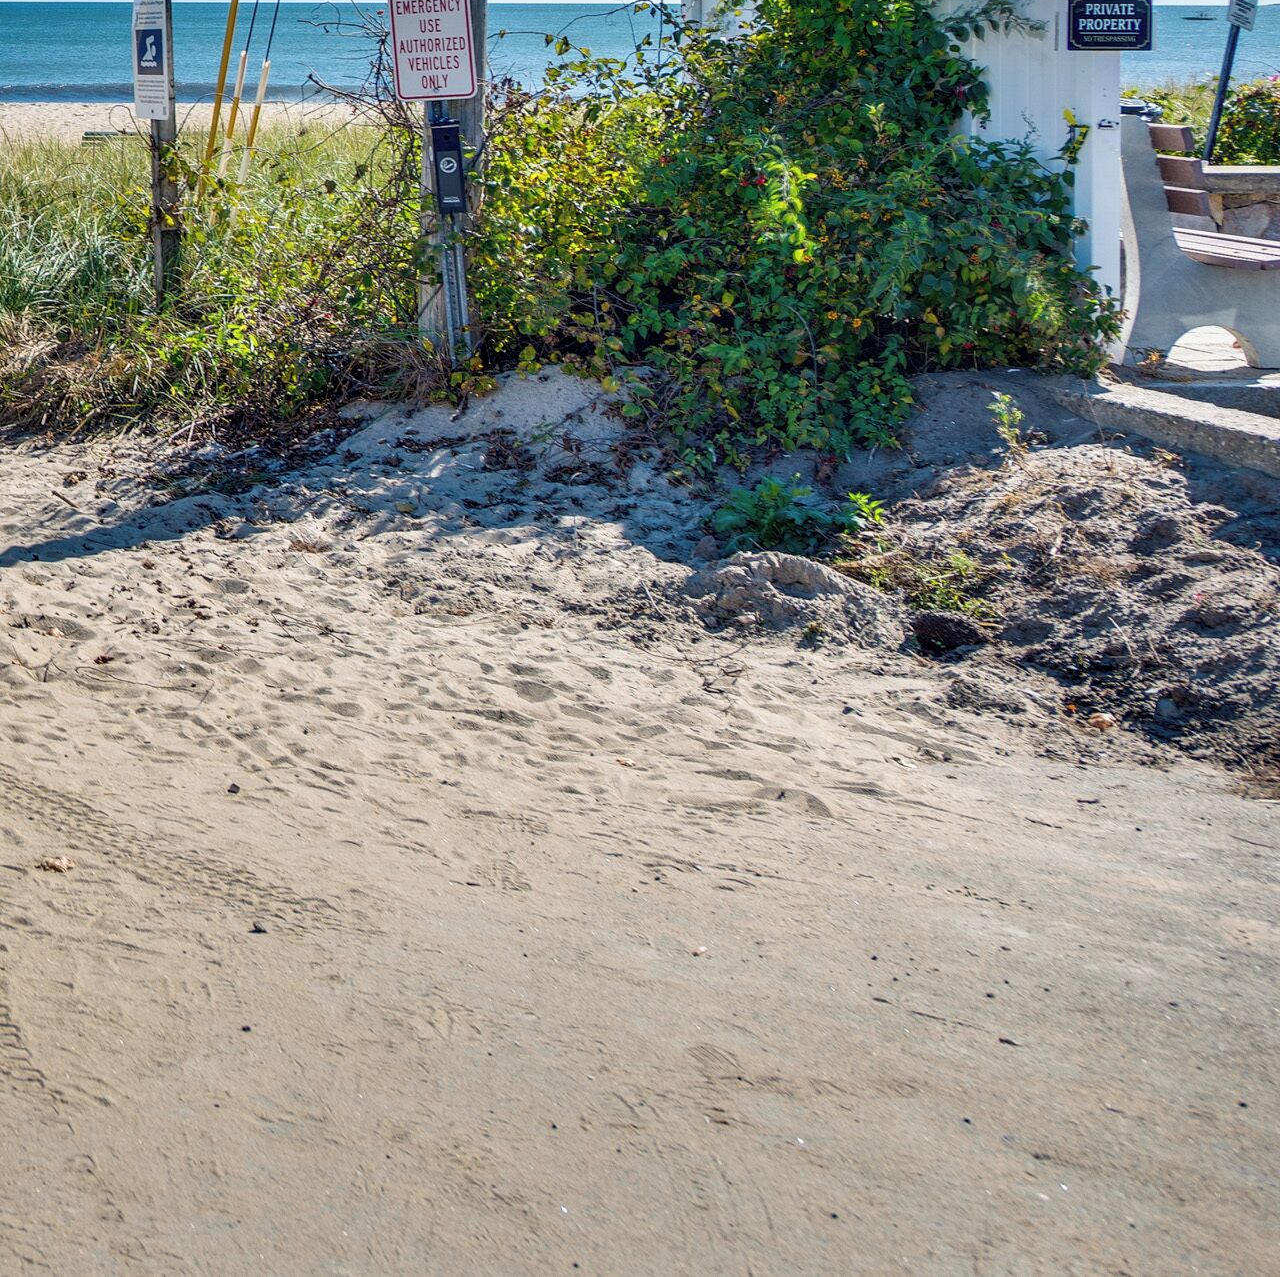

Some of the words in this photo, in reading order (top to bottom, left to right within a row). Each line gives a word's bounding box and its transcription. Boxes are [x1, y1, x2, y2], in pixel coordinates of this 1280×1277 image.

[1085, 3, 1136, 15] PRIVATE
[419, 19, 442, 33] USE
[1078, 18, 1142, 30] PROPERTY
[400, 36, 466, 53] AUTHORIZED
[408, 55, 460, 71] VEHICLES
[421, 74, 448, 89] ONLY
